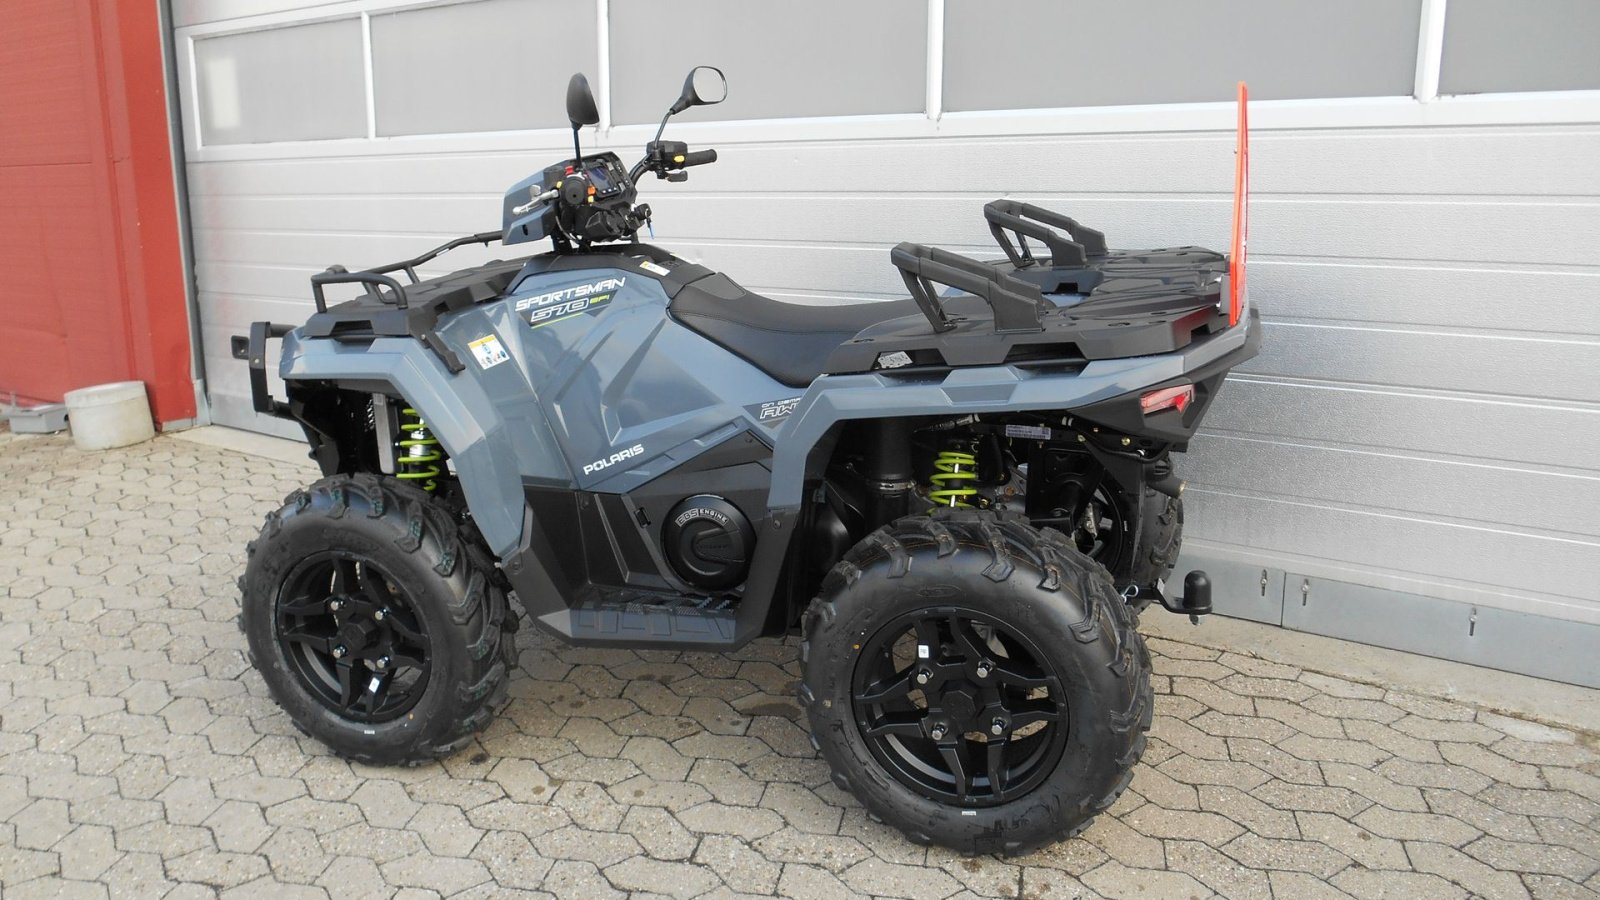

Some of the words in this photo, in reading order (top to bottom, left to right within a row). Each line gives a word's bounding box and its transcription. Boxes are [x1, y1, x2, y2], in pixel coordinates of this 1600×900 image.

[515, 277, 626, 312] SPORTSMAN
[530, 298, 589, 323] 570
[760, 403, 796, 419] AW
[583, 443, 645, 475] POLARIS
[677, 508, 698, 525] EBS
[699, 508, 728, 523] ENGINE
